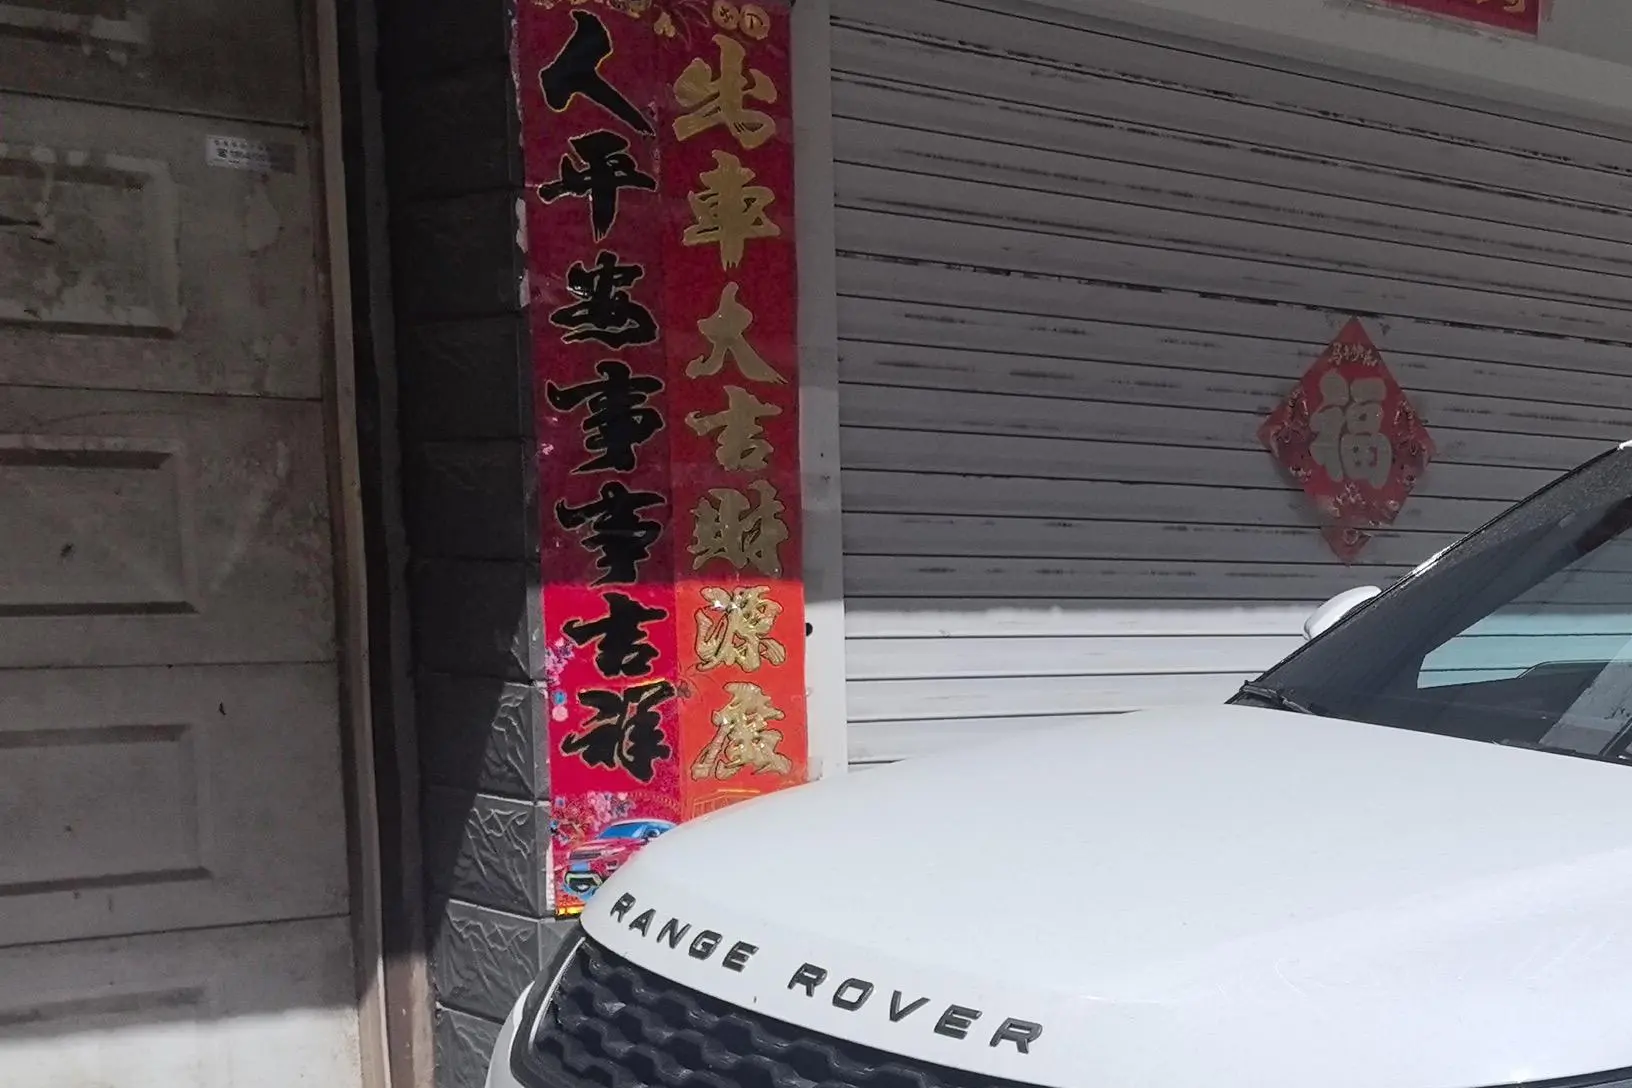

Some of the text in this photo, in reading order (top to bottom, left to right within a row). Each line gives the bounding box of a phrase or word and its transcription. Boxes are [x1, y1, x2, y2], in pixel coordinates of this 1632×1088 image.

[1309, 370, 1392, 490] 福
[608, 892, 1044, 1054] RANGE ROVER
